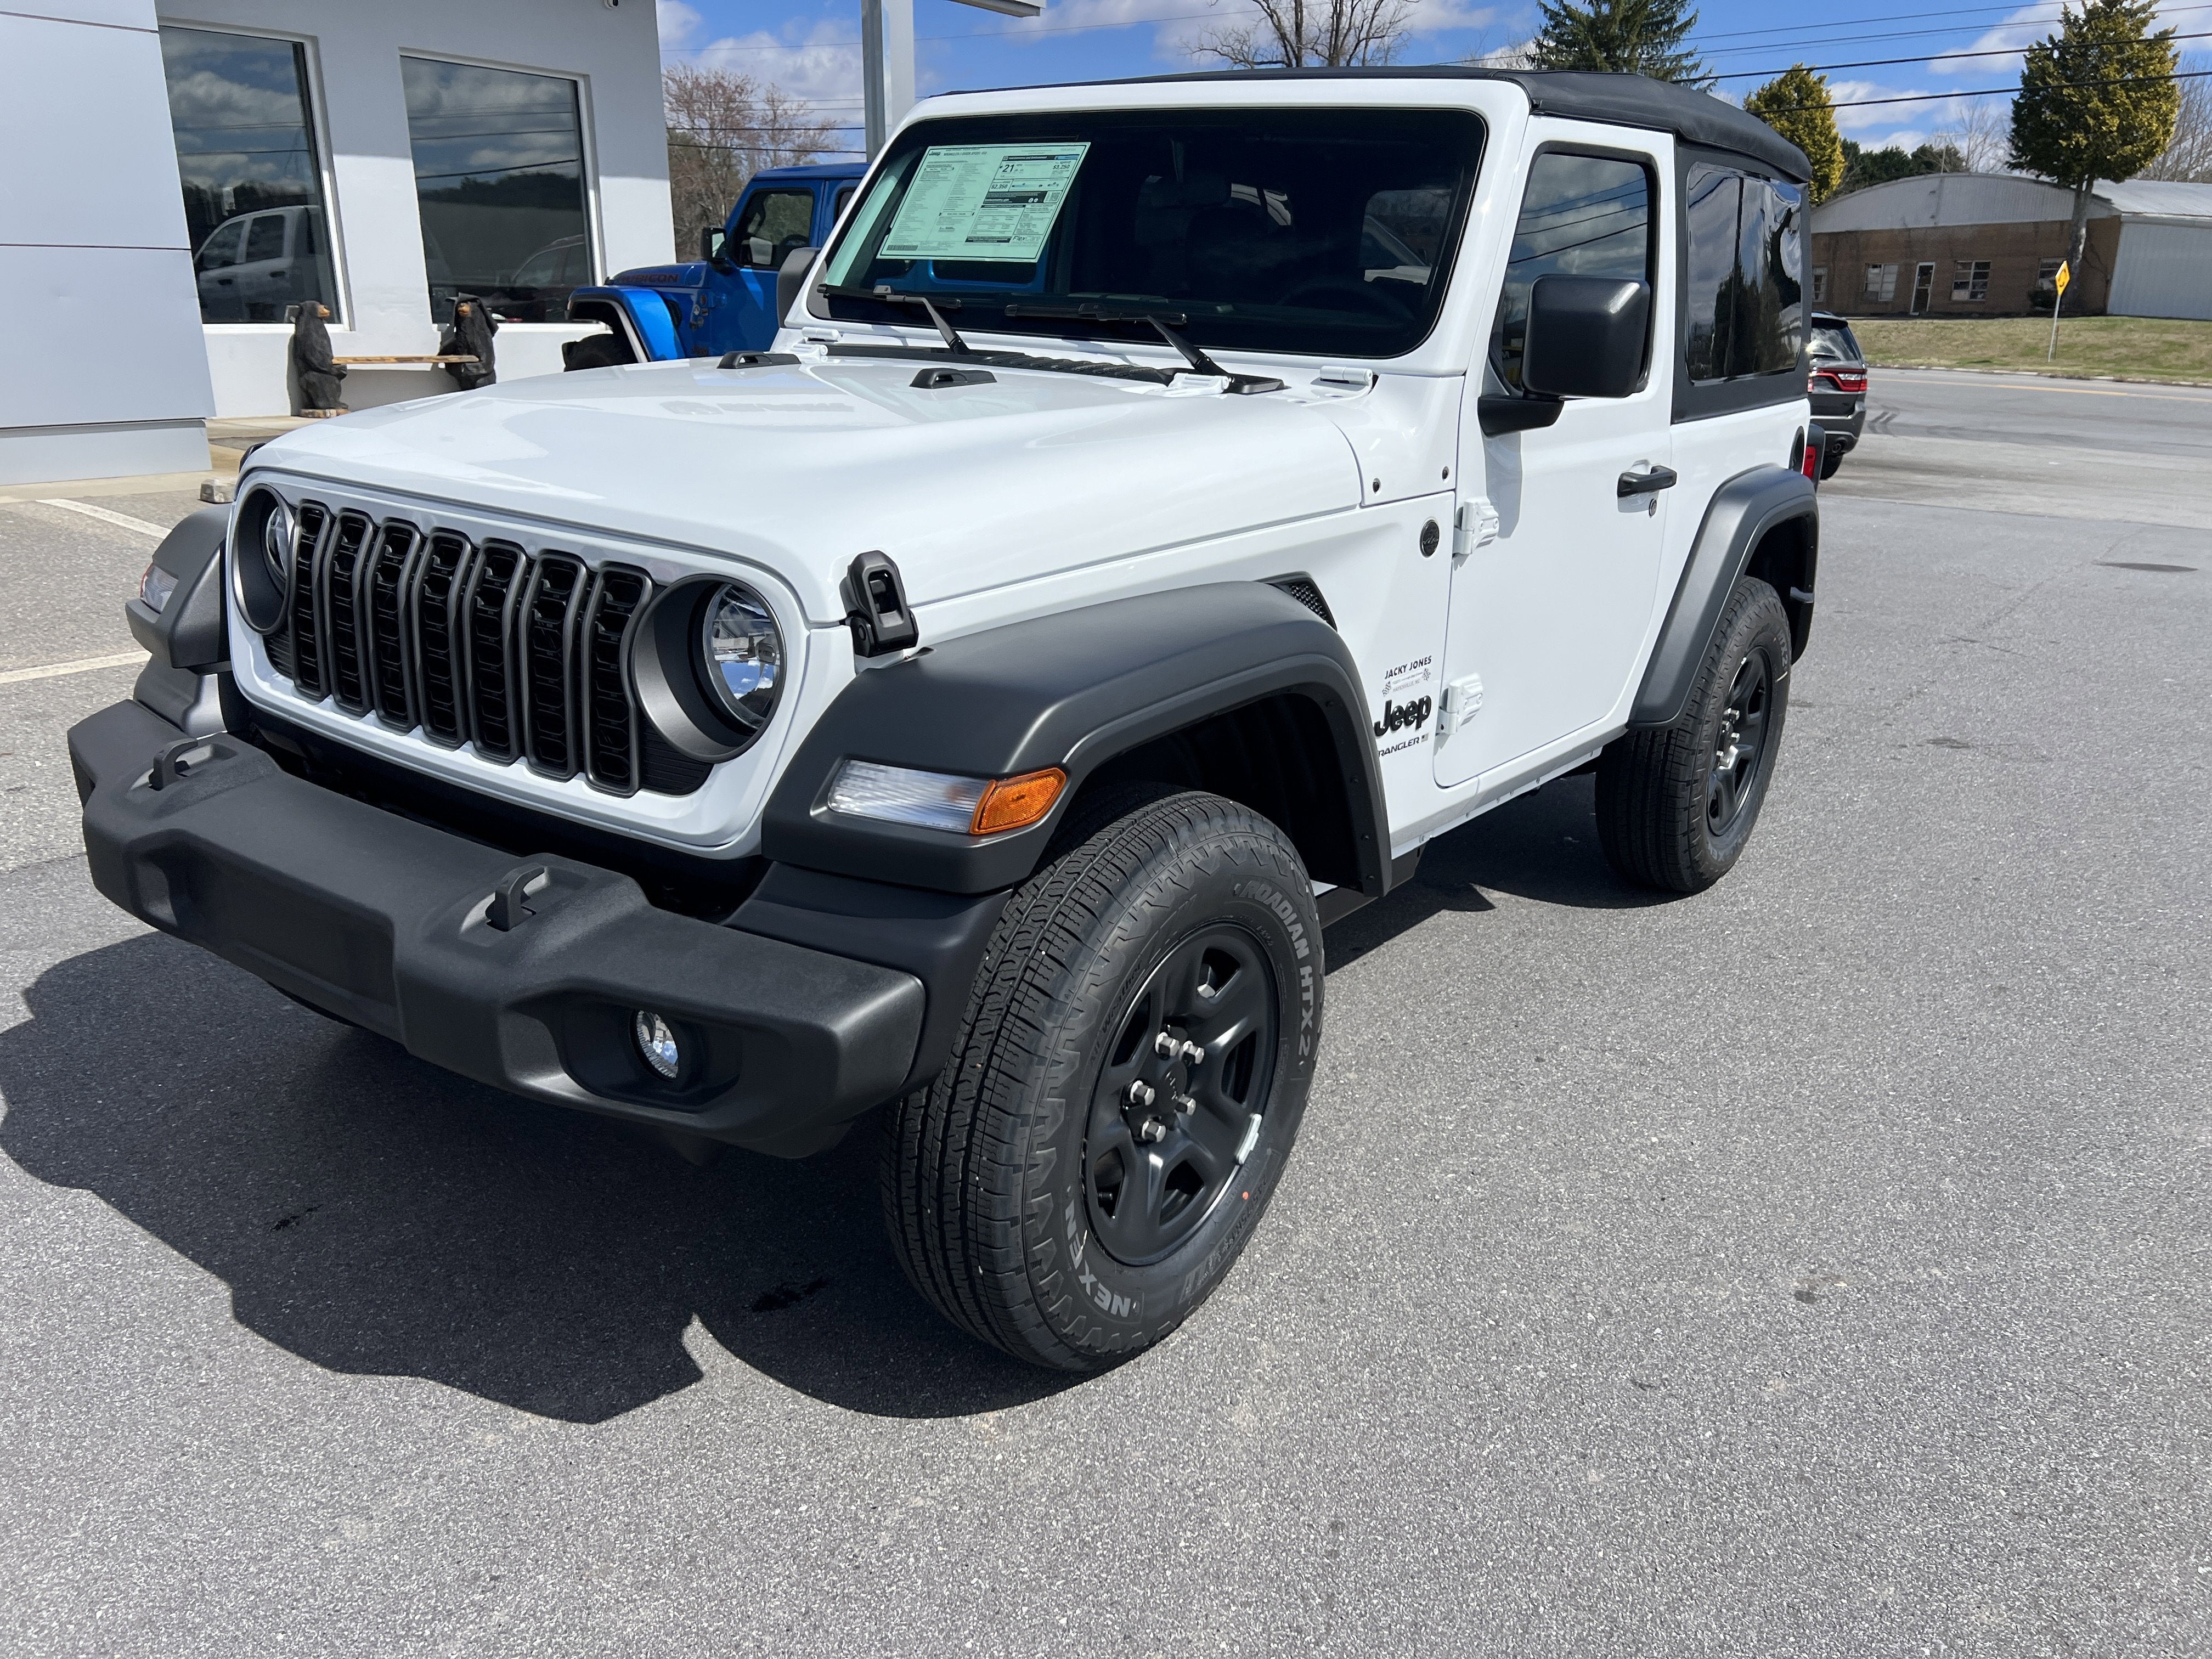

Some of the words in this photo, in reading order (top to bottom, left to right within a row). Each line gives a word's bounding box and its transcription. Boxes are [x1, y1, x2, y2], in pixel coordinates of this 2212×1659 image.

[1002, 164, 1015, 173] 21
[1384, 664, 1408, 680] JACKY
[1409, 655, 1432, 672] JONES
[1374, 695, 1432, 737] Jeep
[1378, 737, 1420, 757] RANGLER
[1239, 880, 1310, 960] ROADIAN
[1299, 965, 1314, 1032] HTX
[1298, 1033, 1311, 1057] 2
[1065, 1199, 1131, 1318] NEXEN
